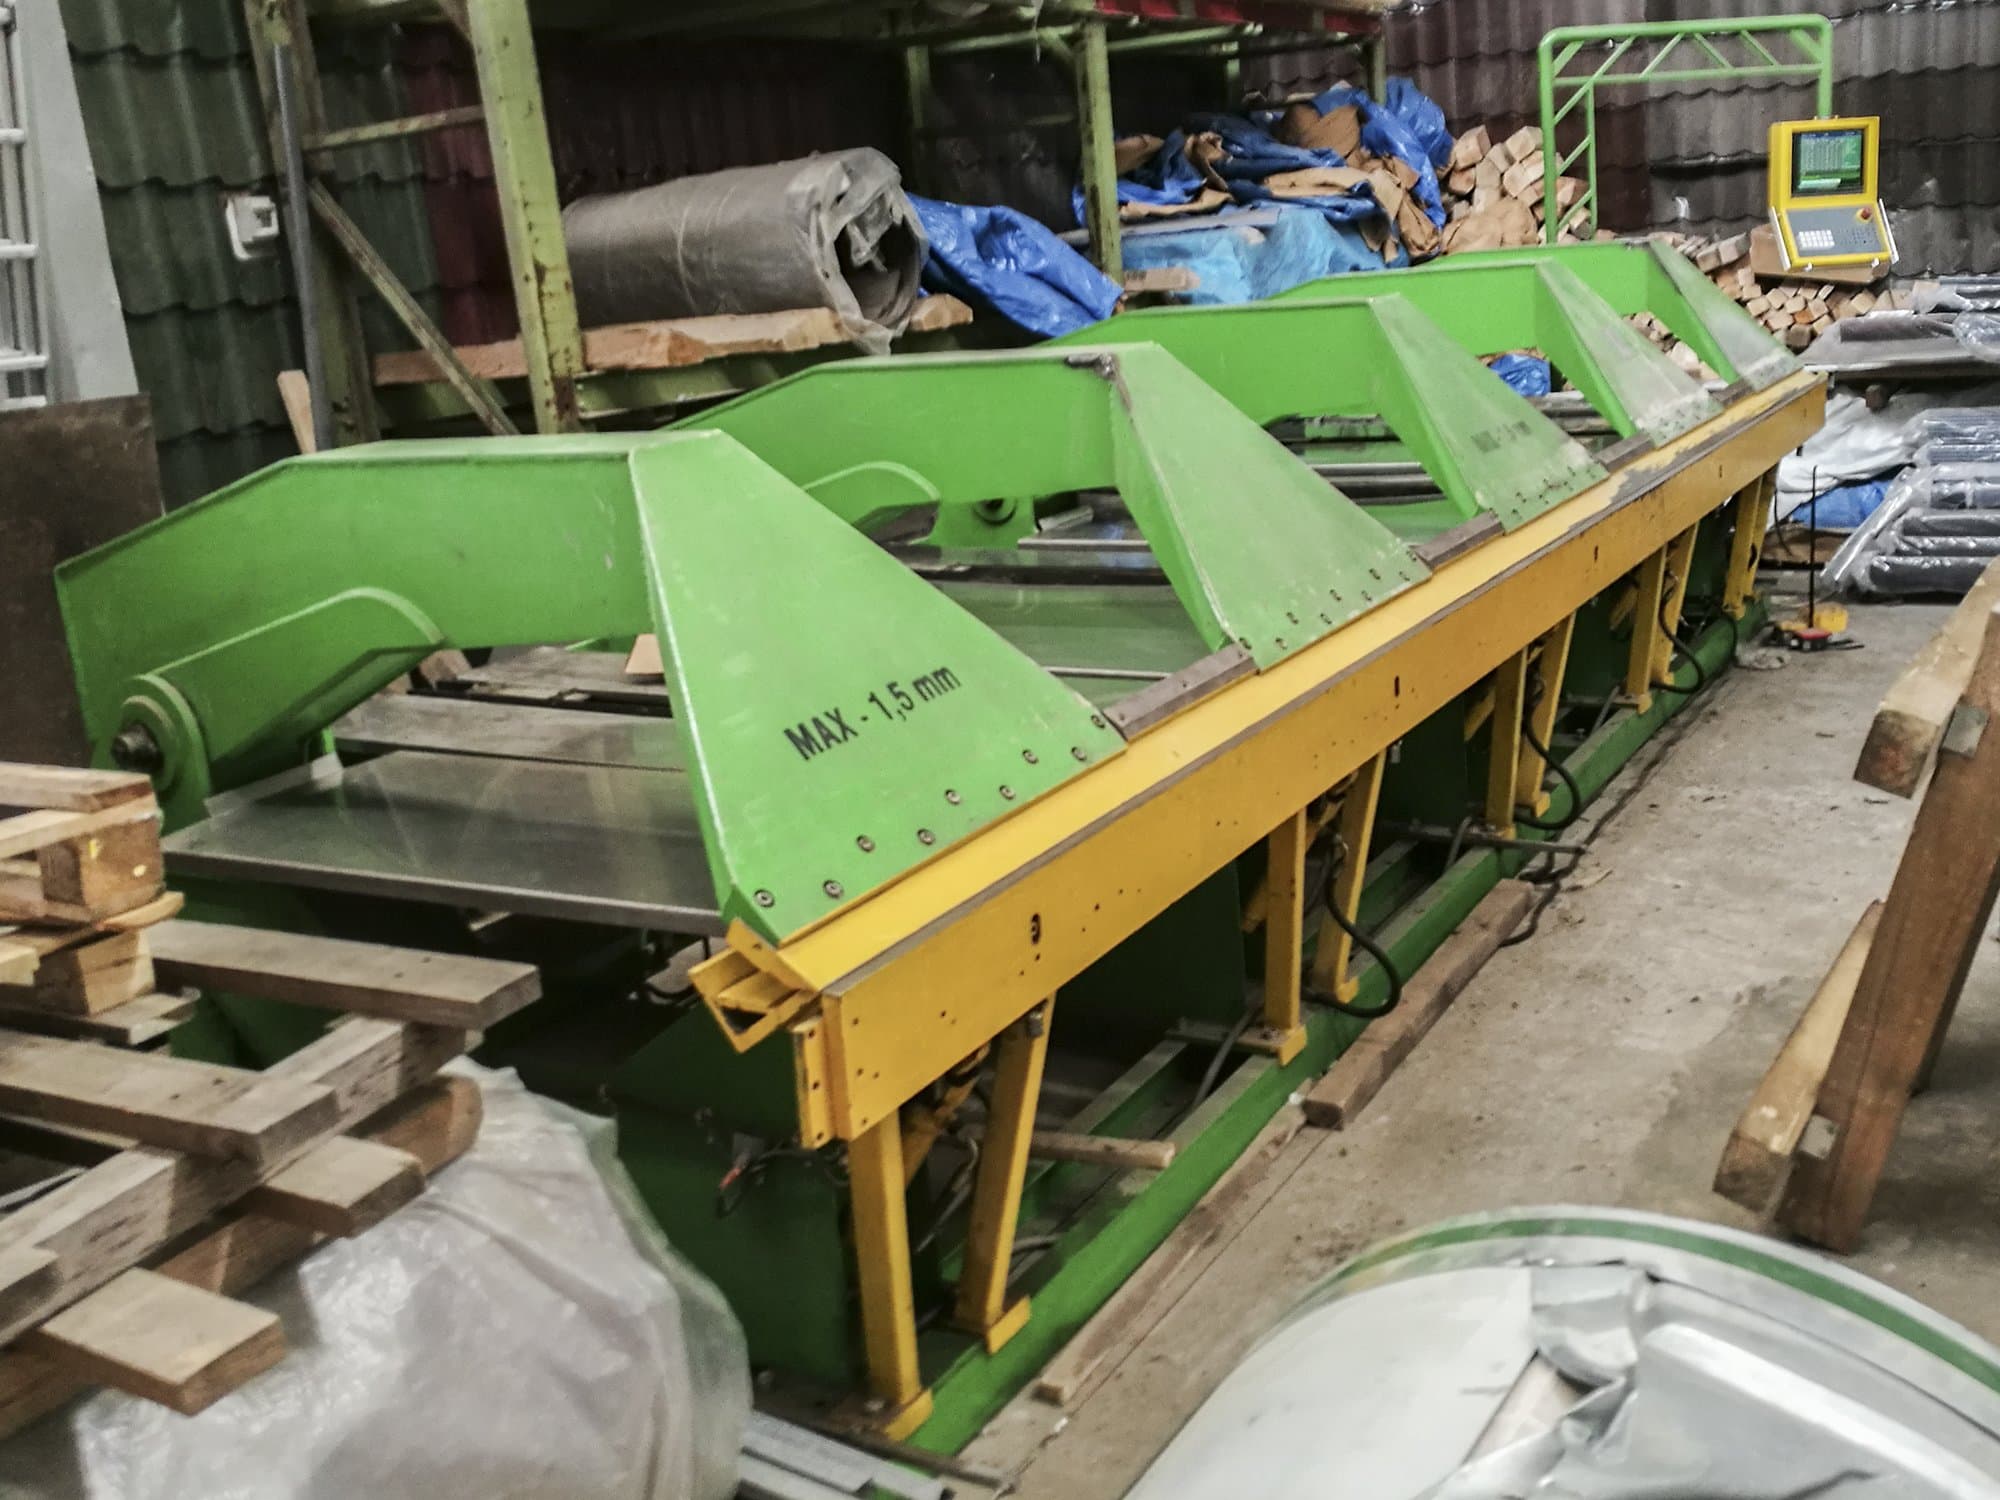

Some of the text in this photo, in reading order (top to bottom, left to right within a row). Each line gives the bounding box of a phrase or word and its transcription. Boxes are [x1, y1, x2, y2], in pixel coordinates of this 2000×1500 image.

[783, 706, 859, 761] MAX
[868, 681, 915, 722] 1,5
[912, 666, 962, 702] mm
